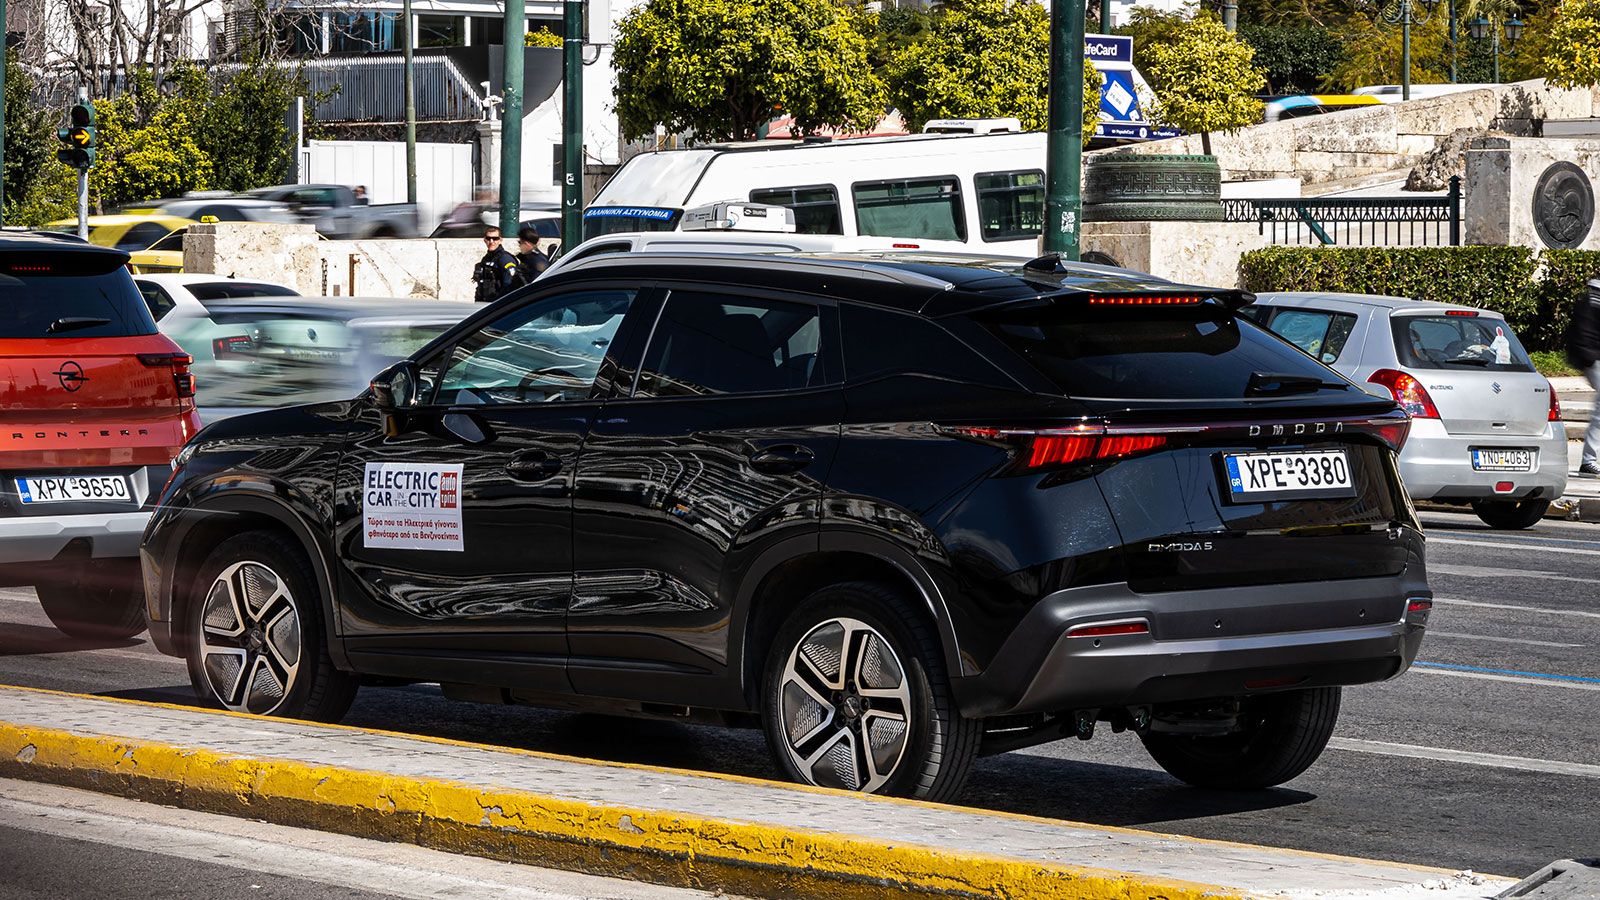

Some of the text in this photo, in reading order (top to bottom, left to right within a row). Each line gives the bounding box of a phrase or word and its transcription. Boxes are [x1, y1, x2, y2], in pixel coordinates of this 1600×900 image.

[586, 208, 669, 219] ΕΛΛΗΝΙΚΗ ΑΣΤΥΝΟΜΙΑ
[368, 470, 439, 490] ELECTRIC
[1244, 456, 1347, 489] XPE-3380
[33, 477, 126, 499] XPK-9650
[367, 491, 393, 507] CAR
[394, 499, 408, 507] THE
[408, 492, 438, 508] CITY
[368, 517, 383, 527] Τώρα
[404, 518, 433, 529] Ηλεκτρικά
[434, 519, 459, 530] γίνονται
[367, 529, 399, 541] φθηνότερα
